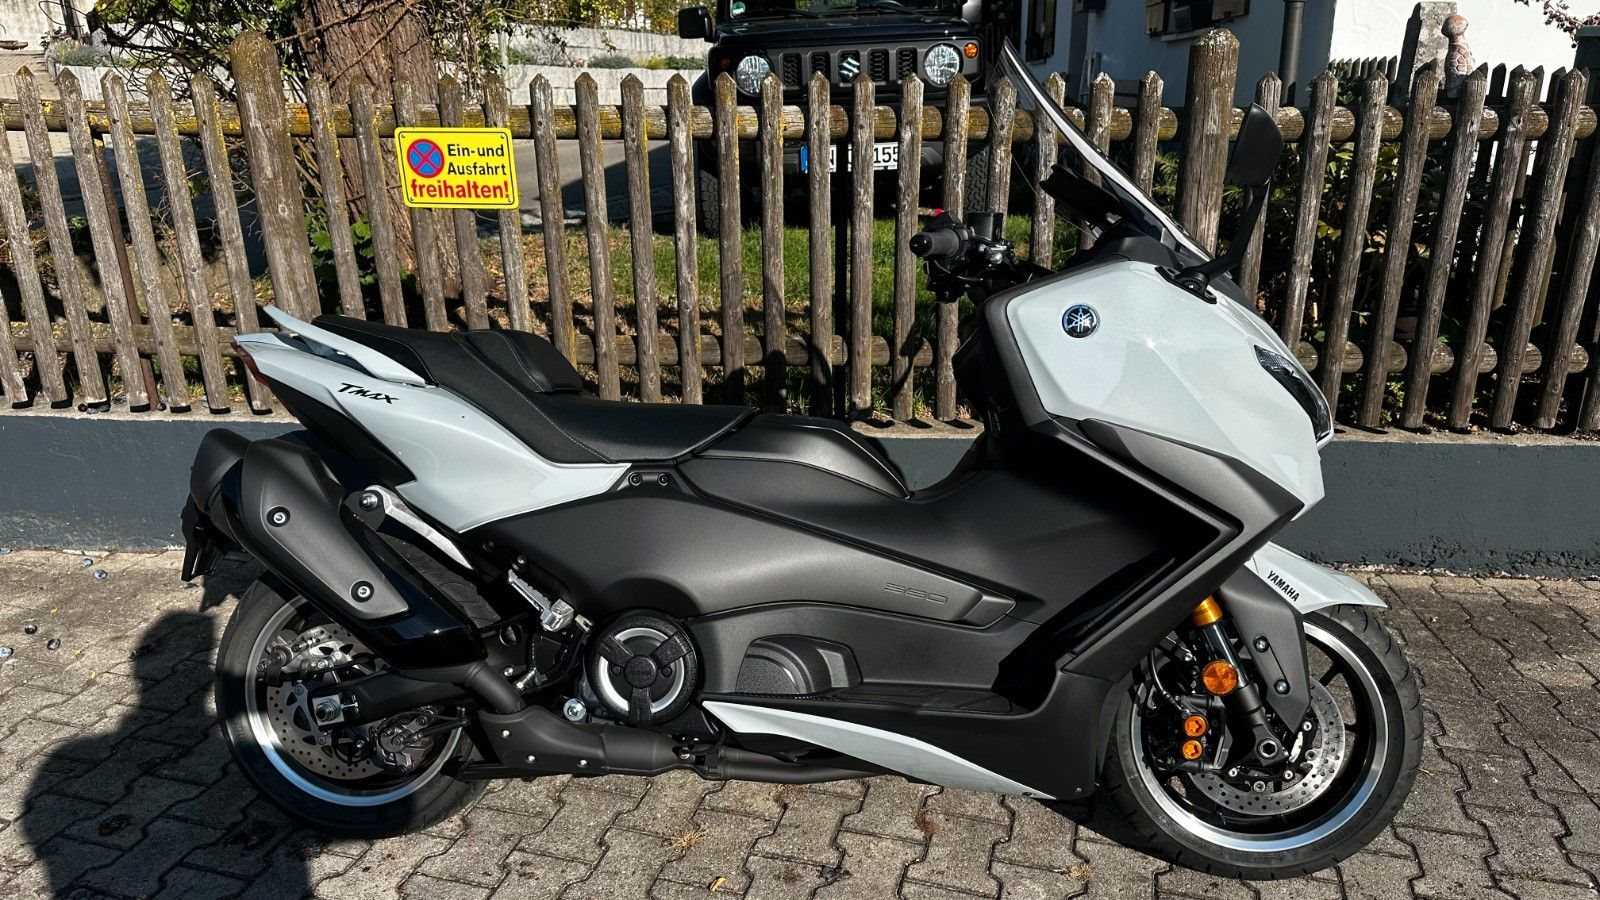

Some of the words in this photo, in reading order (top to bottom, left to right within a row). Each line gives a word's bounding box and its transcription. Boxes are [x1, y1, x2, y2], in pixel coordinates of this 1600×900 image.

[447, 162, 507, 175] Ausfahrt
[411, 178, 509, 199] freihalten!
[1267, 570, 1300, 602] YAMAHA
